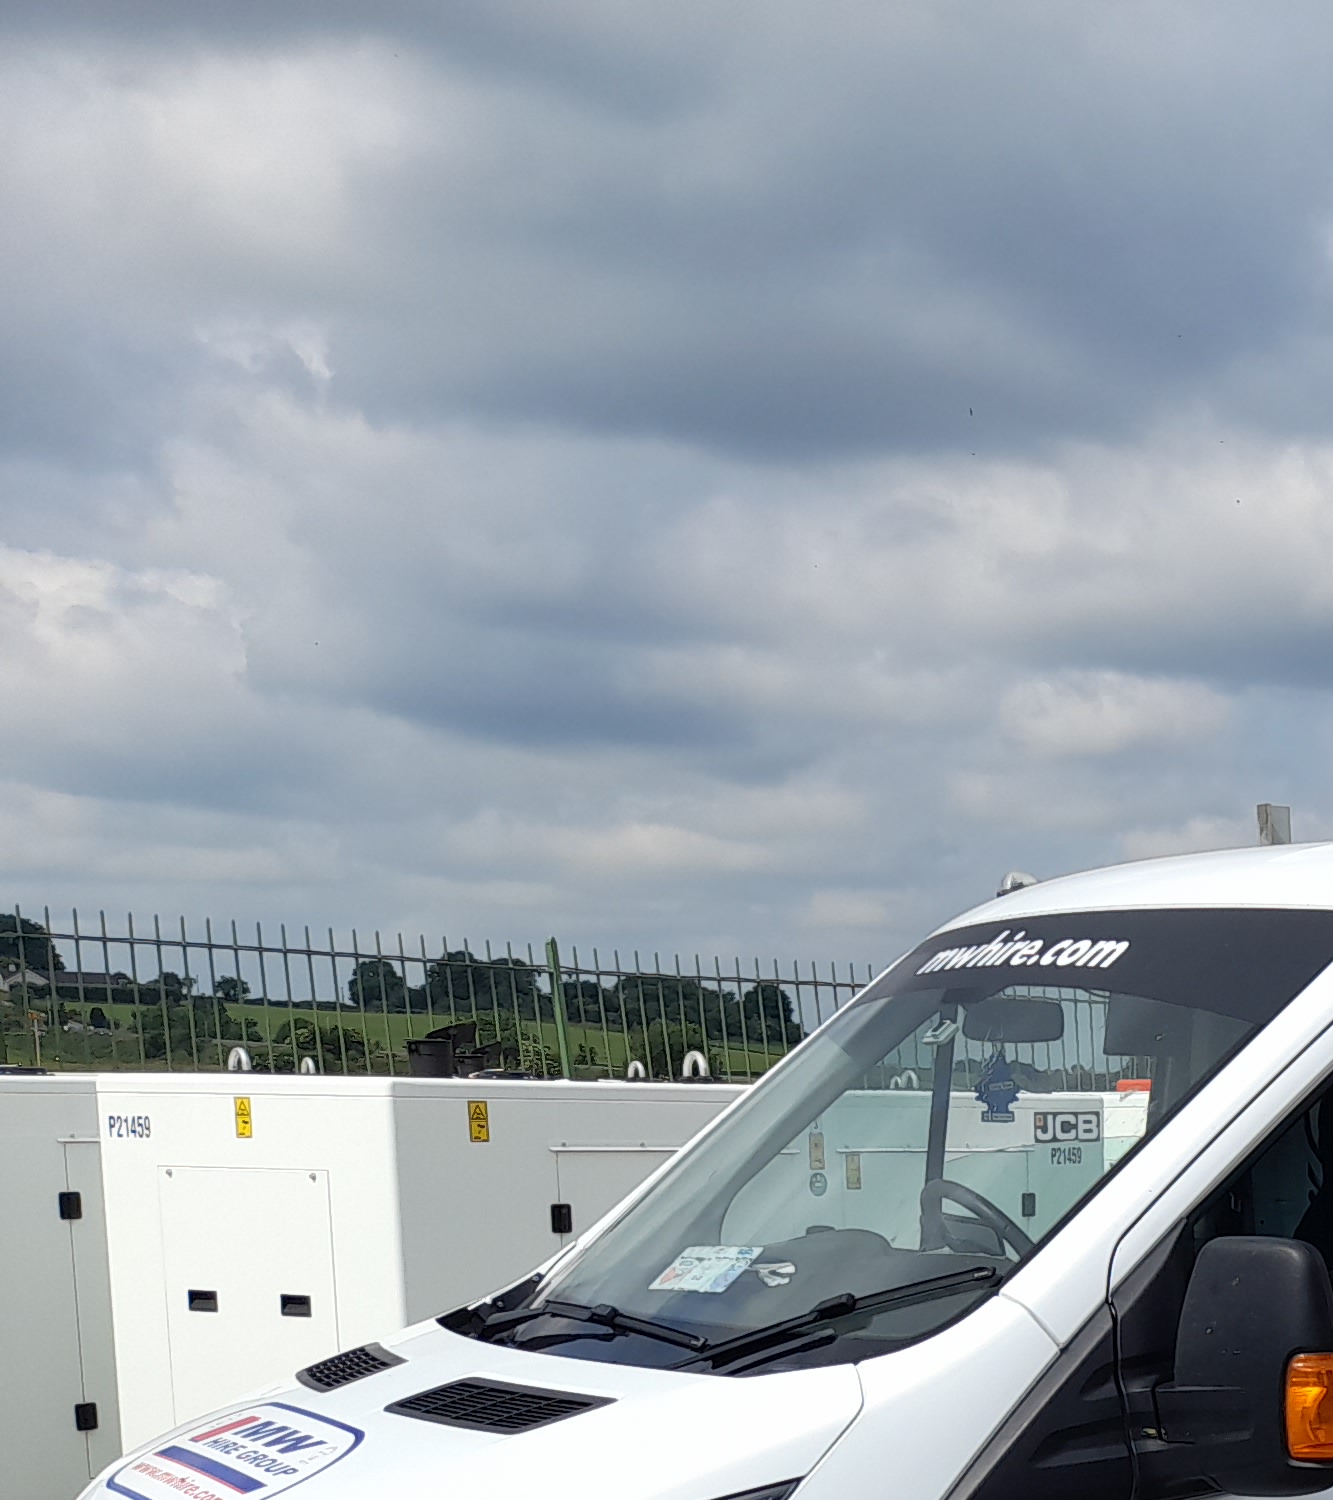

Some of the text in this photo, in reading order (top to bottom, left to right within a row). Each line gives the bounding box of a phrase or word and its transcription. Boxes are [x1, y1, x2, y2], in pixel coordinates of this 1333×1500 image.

[915, 929, 1130, 976] mwhire.com
[108, 1115, 151, 1139] P21459
[1036, 1113, 1099, 1141] JCB
[1050, 1146, 1082, 1166] P21459
[232, 1420, 329, 1455] MW
[202, 1437, 299, 1477] HIRE GROUP
